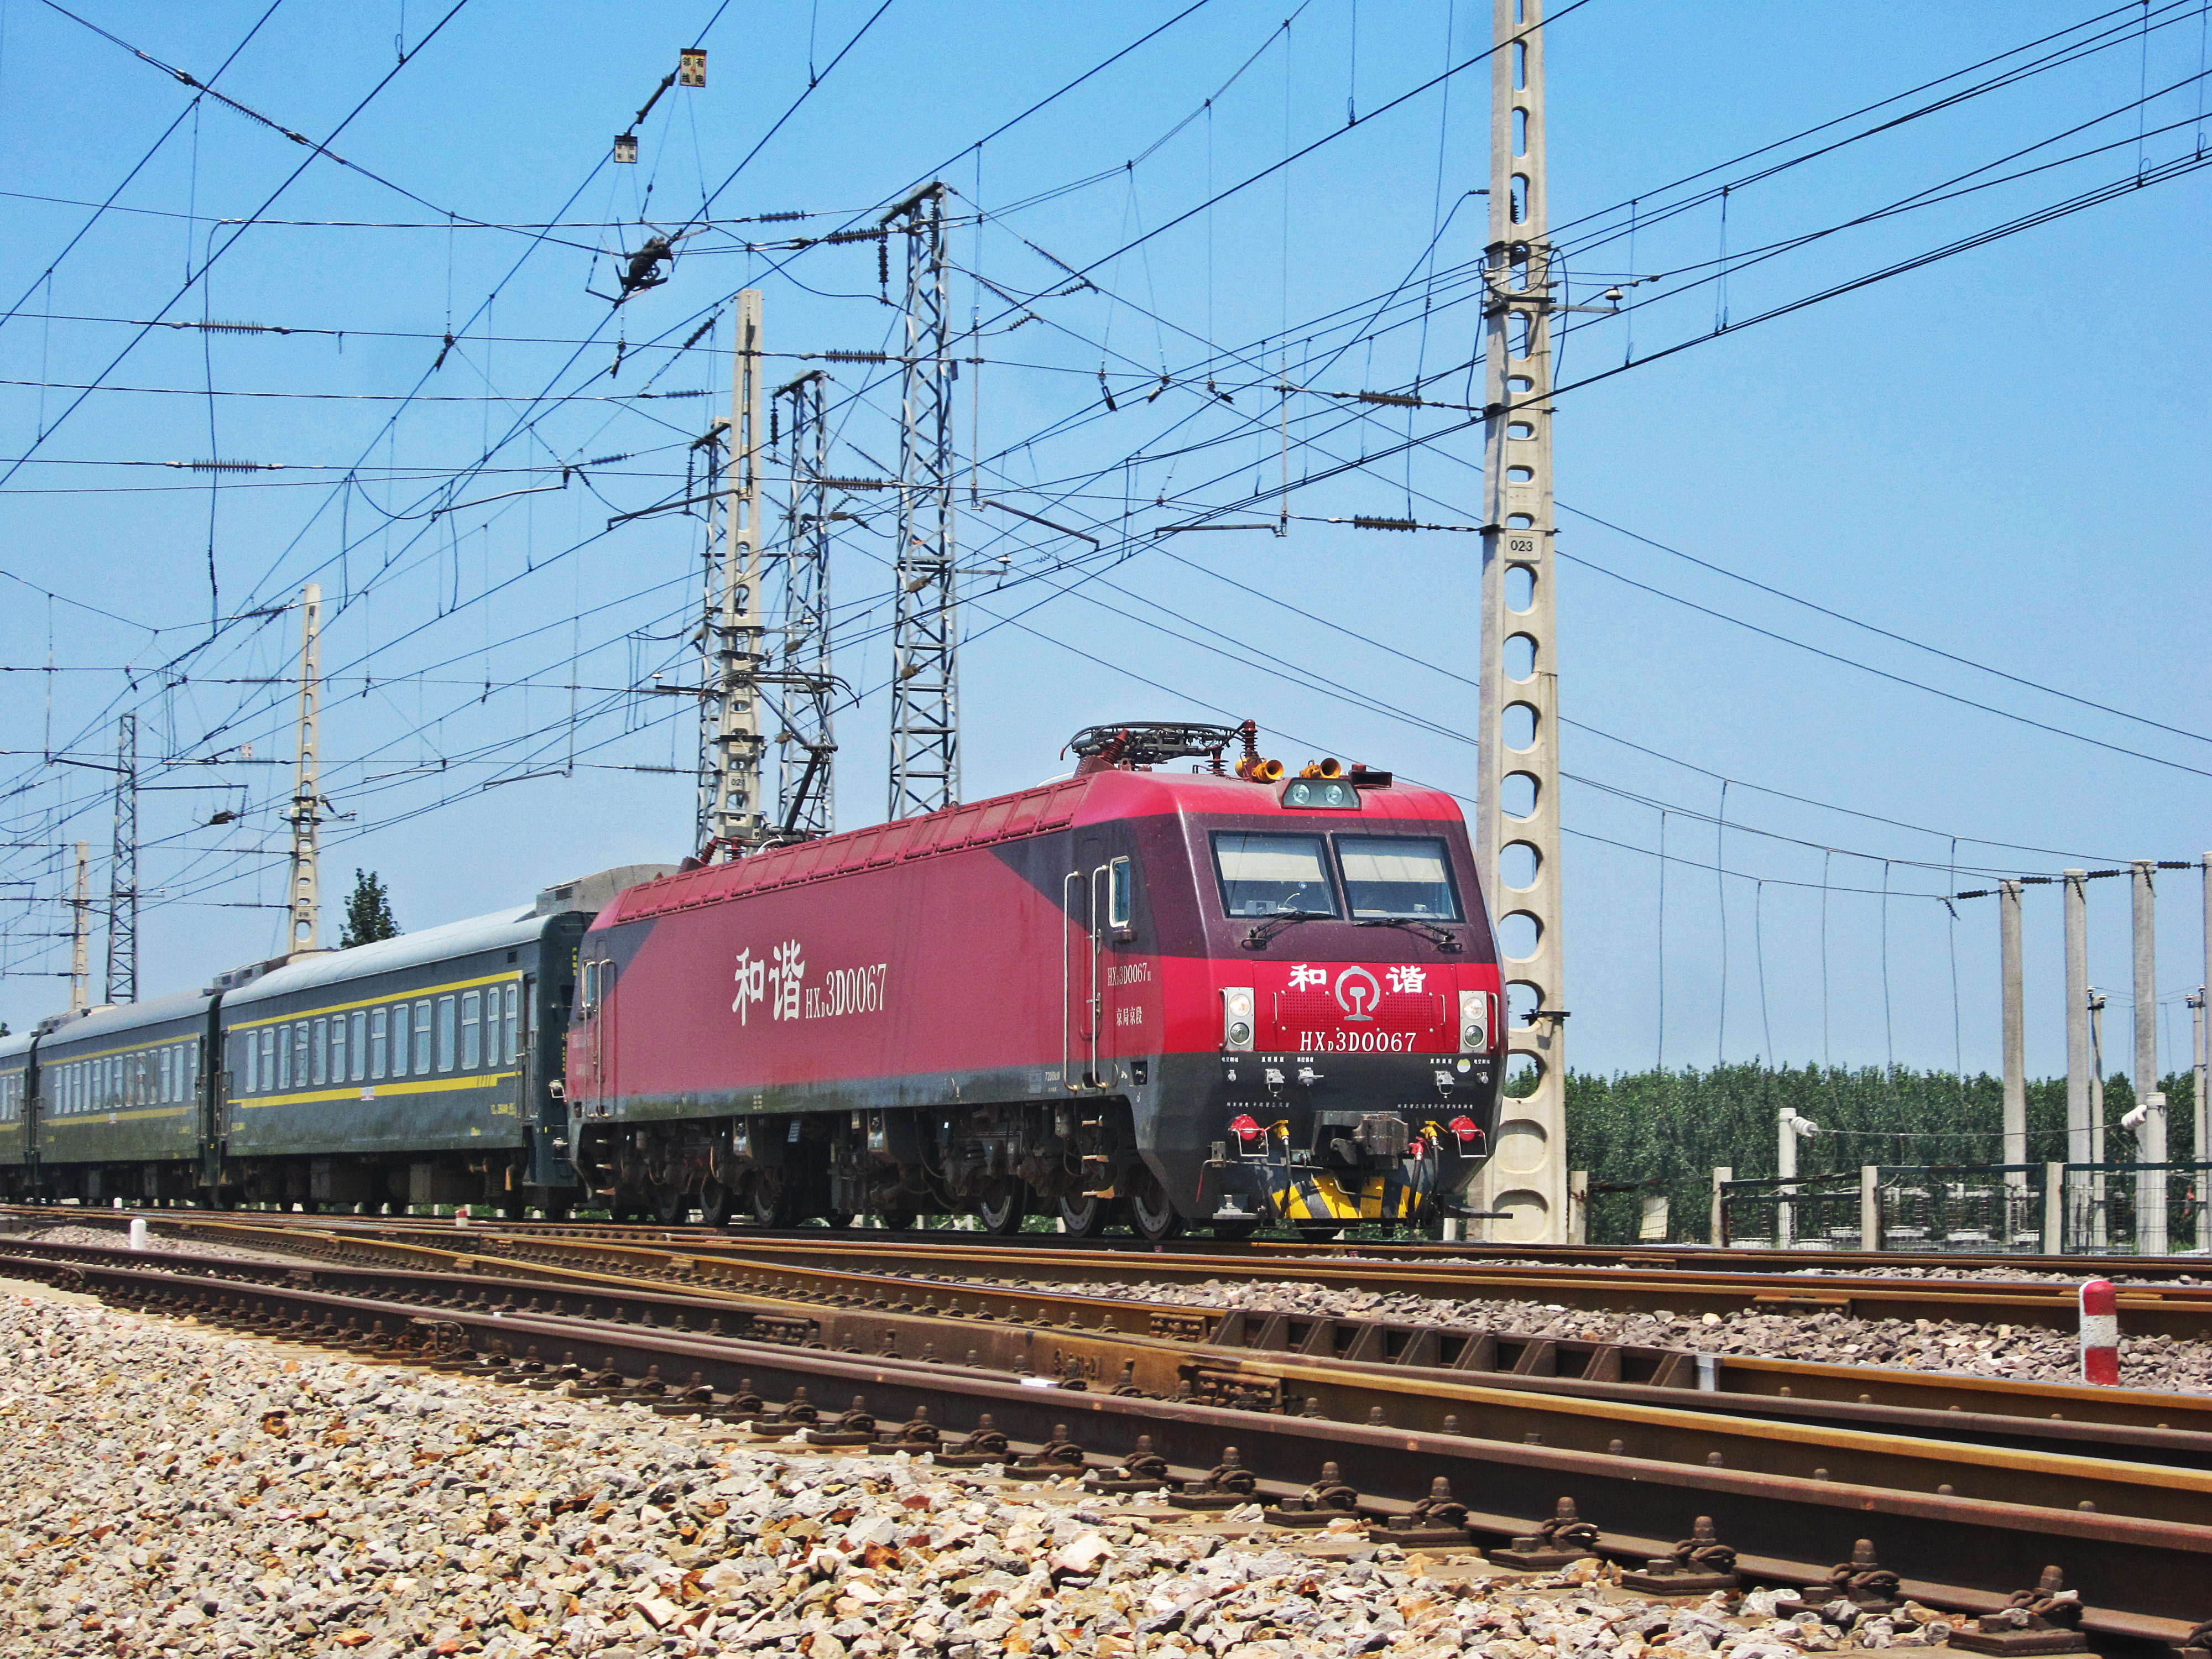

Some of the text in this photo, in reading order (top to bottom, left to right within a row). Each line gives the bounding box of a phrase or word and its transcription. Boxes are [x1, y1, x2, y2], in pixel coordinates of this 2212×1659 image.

[1510, 540, 1533, 551] 023
[732, 939, 805, 1026] 和谐
[1288, 964, 1427, 993] 和 谐
[1300, 1031, 1417, 1052] HXD3D0067
